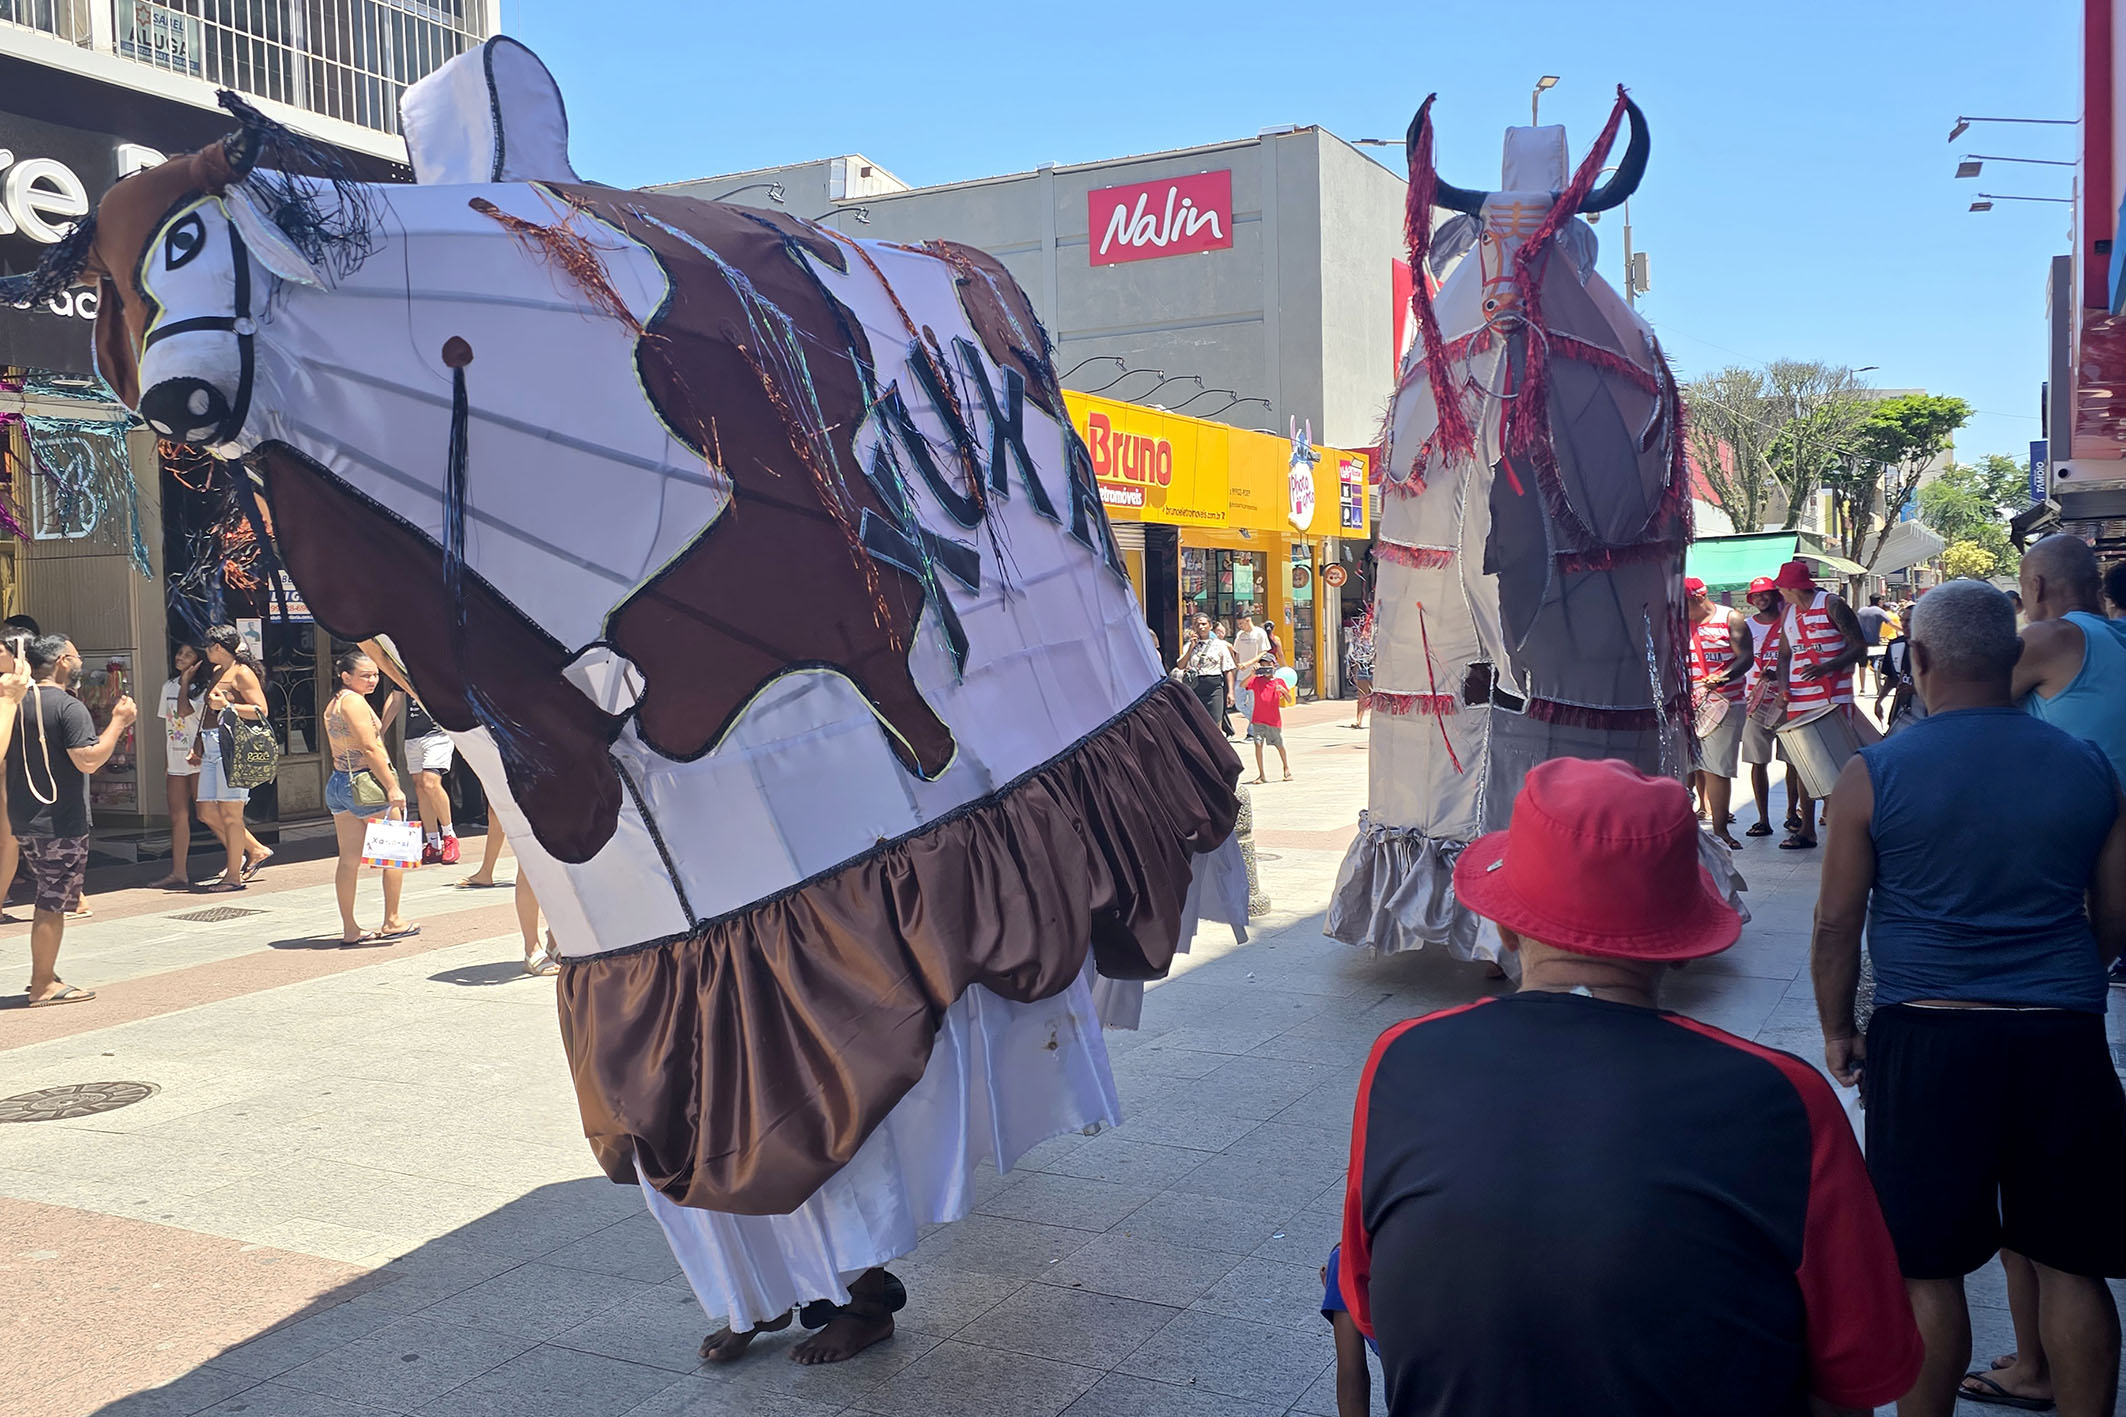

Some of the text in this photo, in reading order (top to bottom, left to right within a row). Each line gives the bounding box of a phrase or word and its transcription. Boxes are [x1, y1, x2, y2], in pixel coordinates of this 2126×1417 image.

[129, 26, 191, 58] ALUGA
[1100, 186, 1223, 255] Nalin
[1089, 412, 1172, 486] Bruno
[1100, 486, 1143, 505] etromóveis
[2036, 461, 2045, 493] TAMOIO
[859, 334, 1129, 686] XUXA
